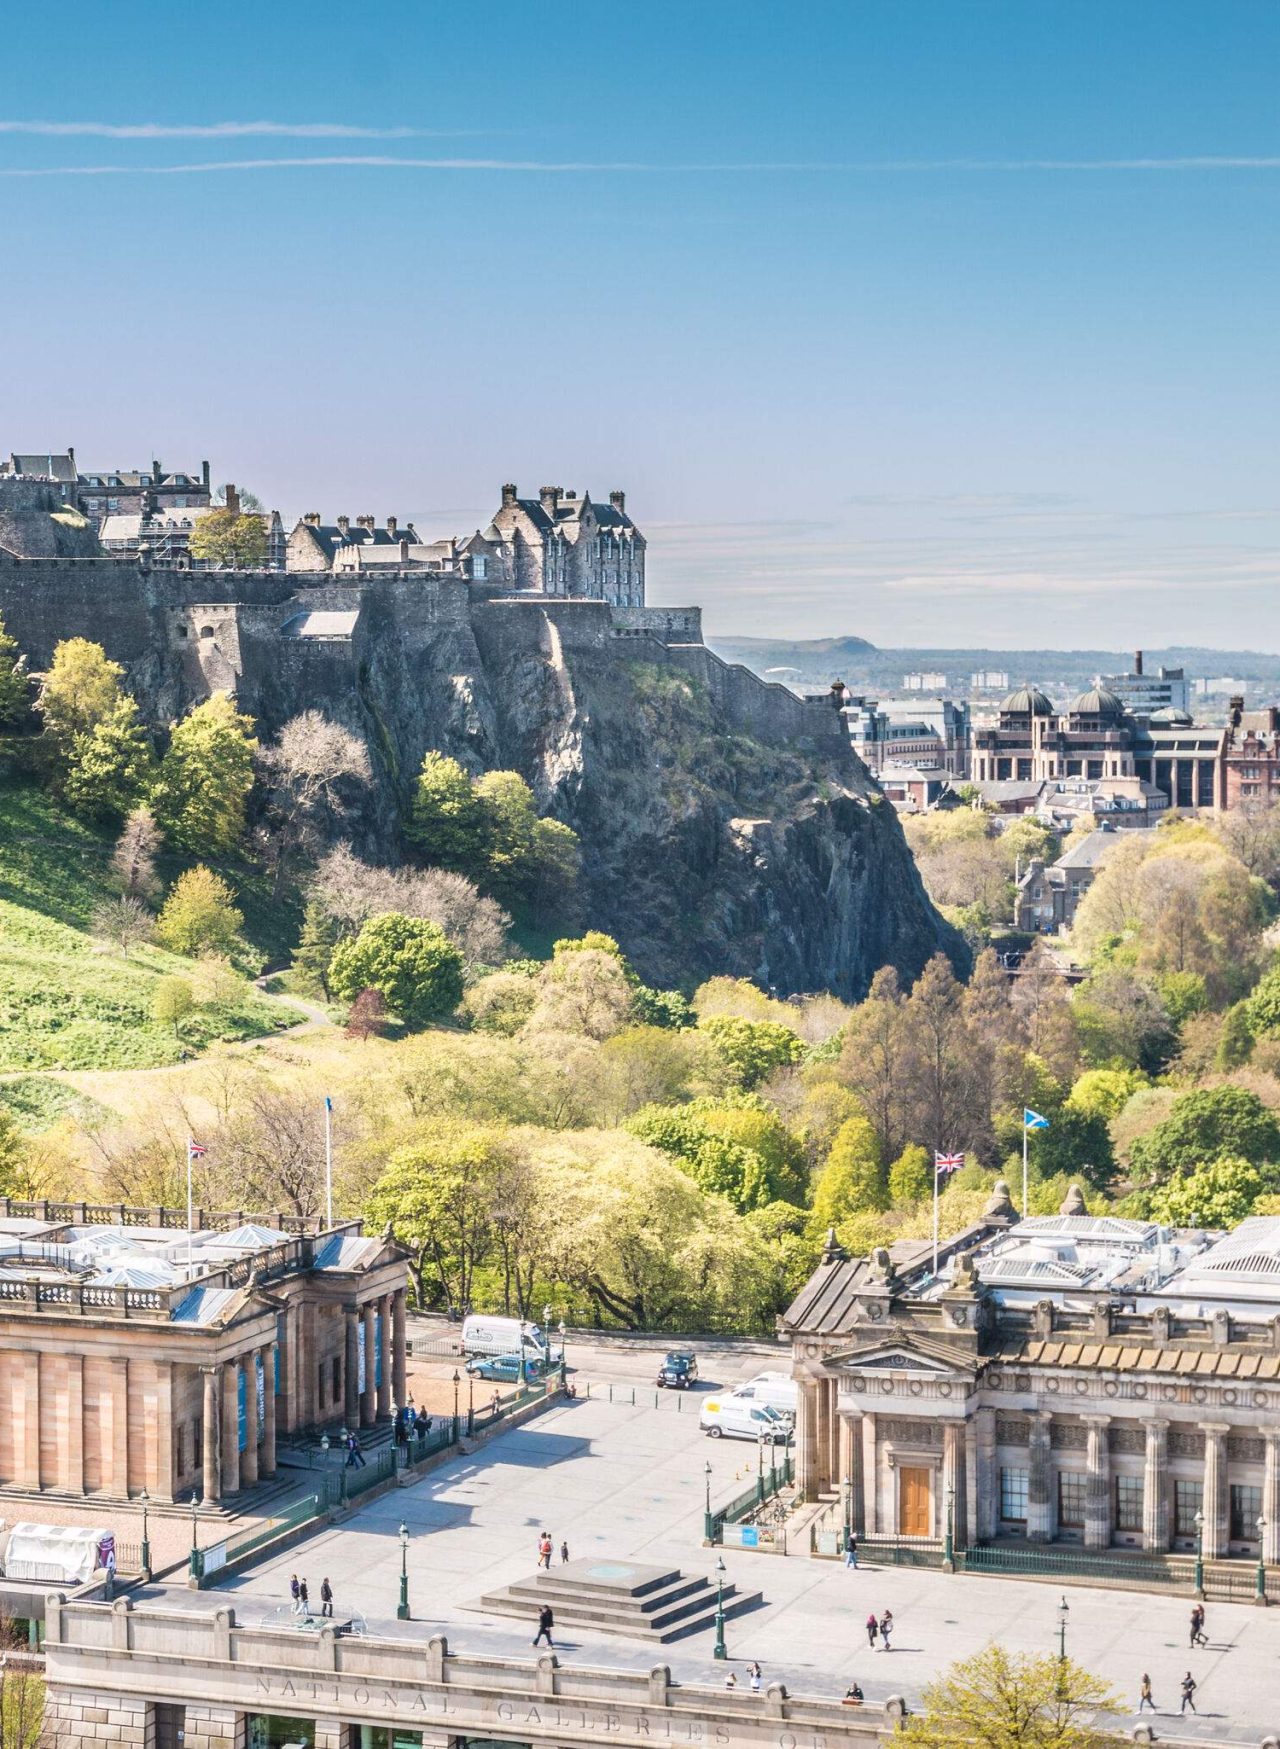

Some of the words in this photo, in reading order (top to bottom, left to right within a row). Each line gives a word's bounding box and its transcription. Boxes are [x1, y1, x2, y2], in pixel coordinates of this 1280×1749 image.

[255, 1677, 456, 1714] NATIONAL
[497, 1702, 731, 1745] GALLERIES
[780, 1733, 827, 1749] OF
